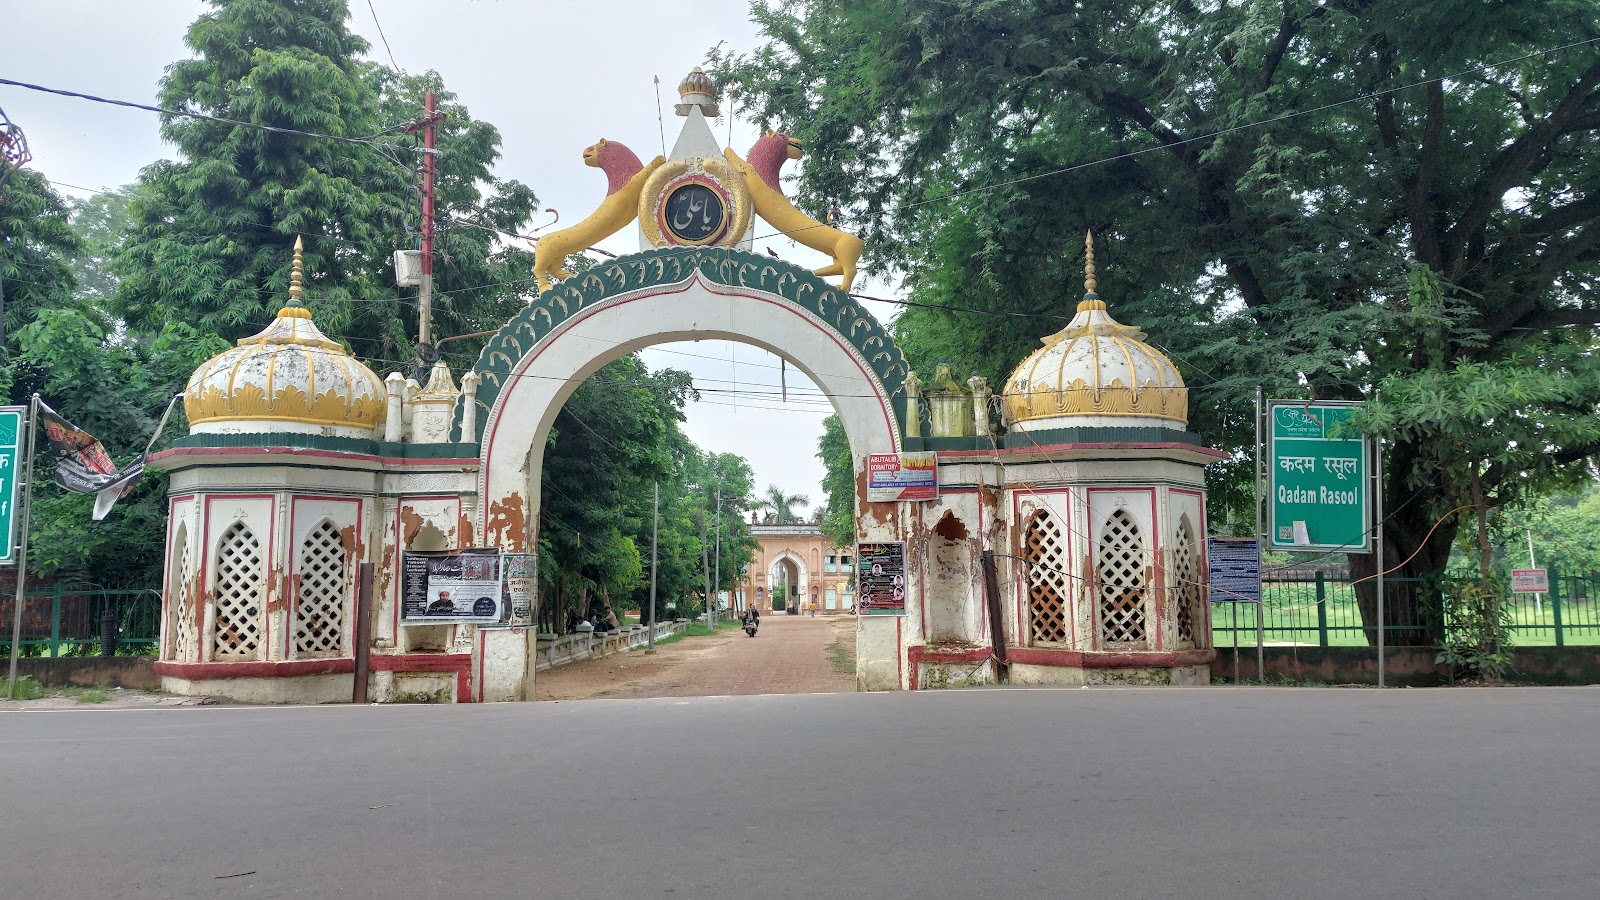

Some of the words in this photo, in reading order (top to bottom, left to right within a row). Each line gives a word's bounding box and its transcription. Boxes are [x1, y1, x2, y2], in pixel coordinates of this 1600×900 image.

[871, 463, 898, 471] DORMITORY
[1278, 456, 1316, 474] कदम
[1322, 457, 1358, 480] रसूल
[1278, 485, 1317, 504] Qadam
[1320, 486, 1358, 505] Rasool
